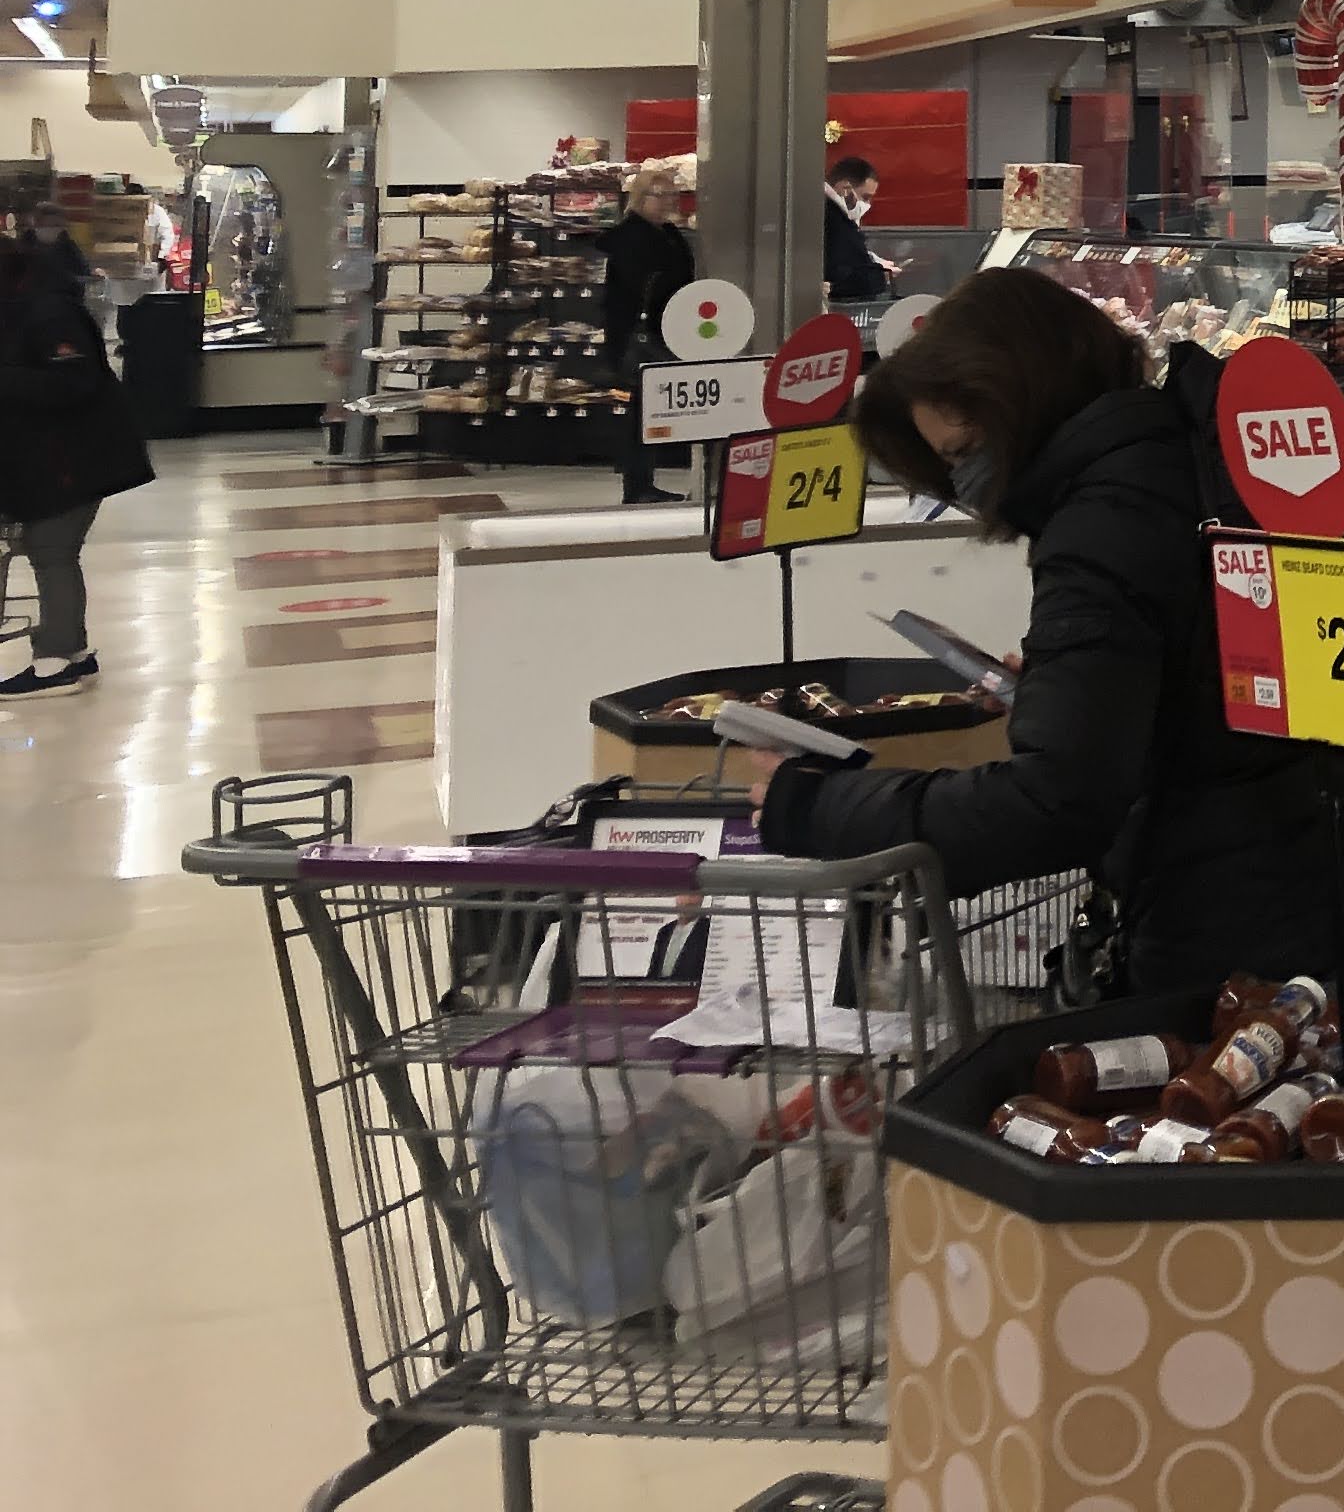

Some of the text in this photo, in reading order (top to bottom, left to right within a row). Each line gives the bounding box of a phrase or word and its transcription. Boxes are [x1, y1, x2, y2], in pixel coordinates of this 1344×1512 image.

[783, 355, 842, 387] SALE
[1246, 417, 1332, 460] SALE
[732, 442, 772, 465] SALE
[1218, 550, 1267, 575] SALE
[635, 829, 706, 845] PROSPERITY
